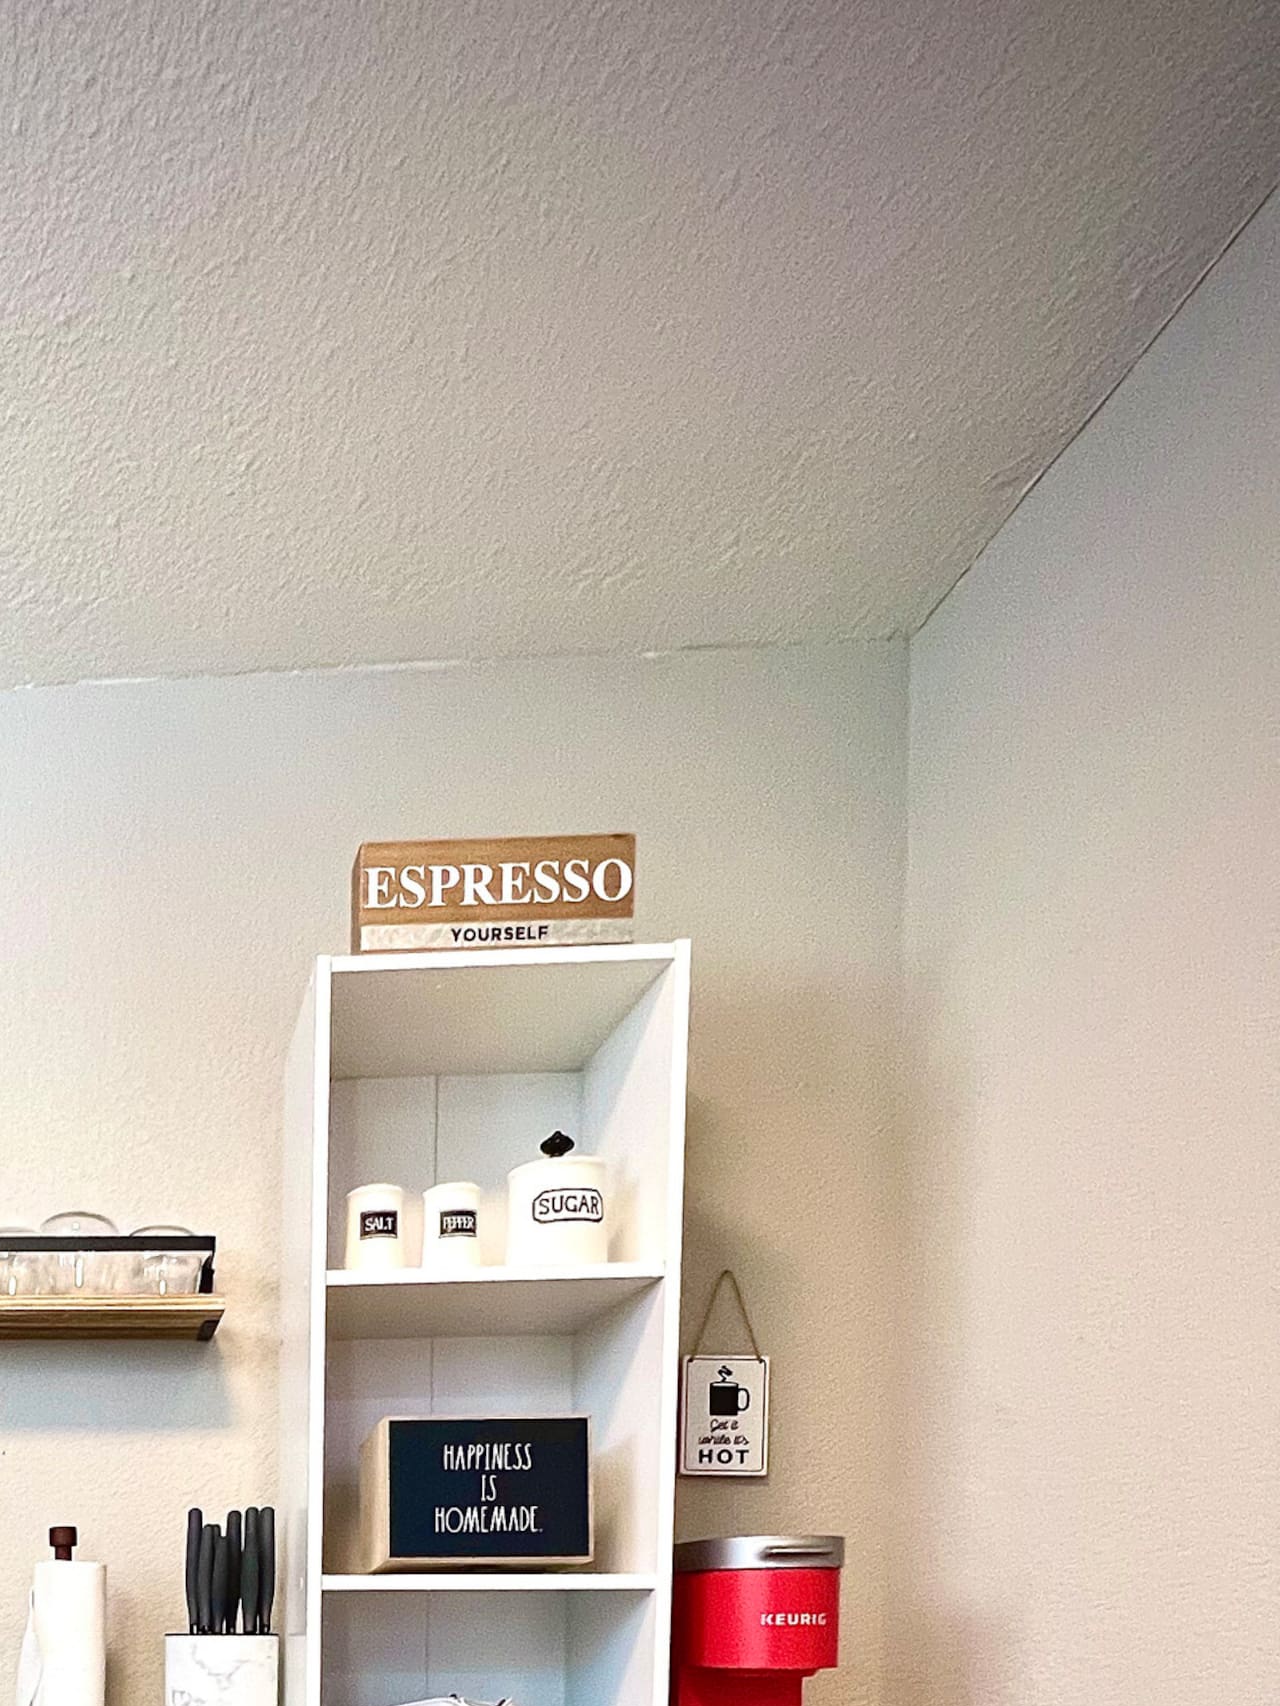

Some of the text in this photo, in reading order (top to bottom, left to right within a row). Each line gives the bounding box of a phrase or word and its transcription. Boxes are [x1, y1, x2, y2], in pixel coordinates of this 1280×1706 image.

[363, 858, 633, 910] ESPRESSO
[451, 925, 549, 942] YOURSELF
[538, 1195, 600, 1215] SUGAR
[364, 1216, 395, 1232] SALT
[442, 1215, 475, 1231] PEPPER
[442, 1442, 533, 1471] HAPPINESS
[698, 1448, 750, 1465] HOT
[480, 1474, 498, 1502] IS
[760, 1612, 828, 1626] KEURIG
